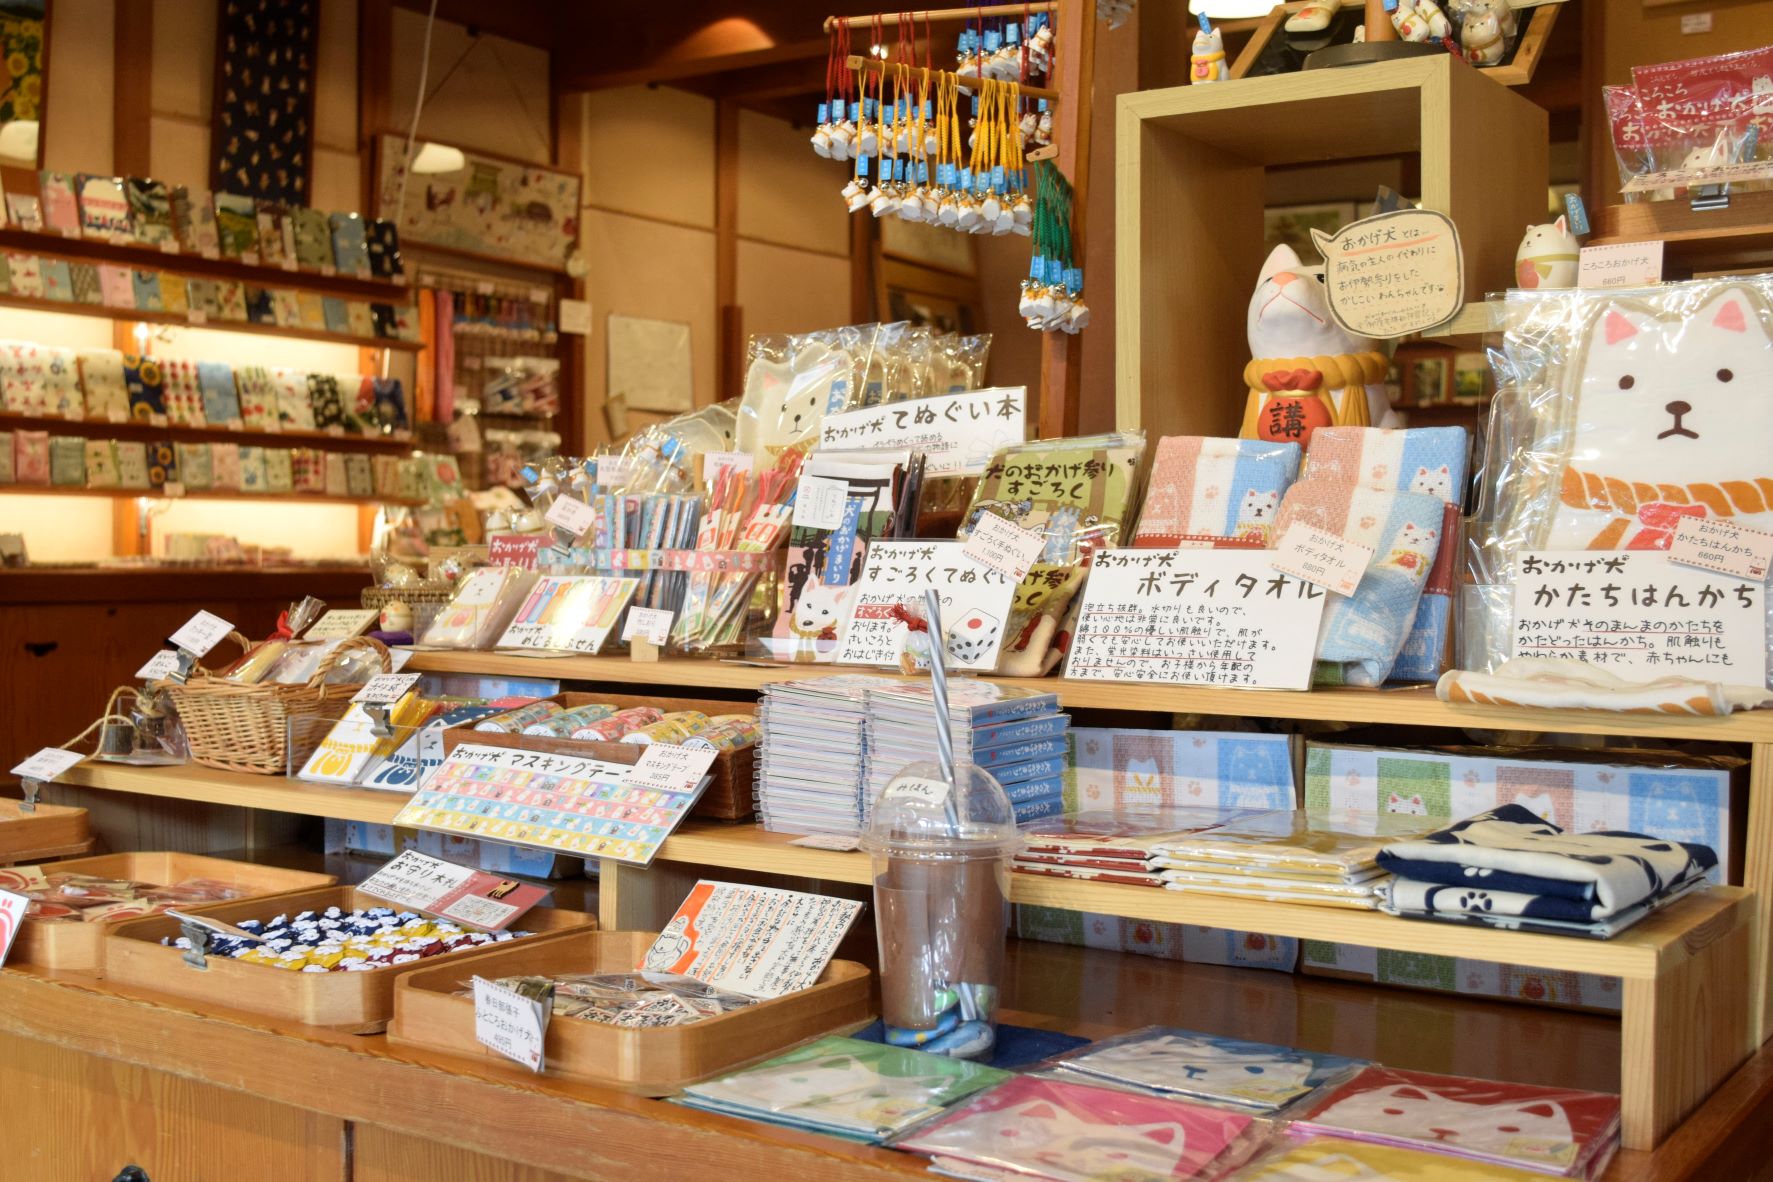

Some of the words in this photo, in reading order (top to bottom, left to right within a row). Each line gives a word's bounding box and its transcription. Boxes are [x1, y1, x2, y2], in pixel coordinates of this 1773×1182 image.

[1582, 255, 1649, 271] ころころおかげ犬
[824, 416, 885, 443] おかげ犬
[892, 393, 1021, 430] てぬぐい本
[1269, 401, 1306, 437] 講
[985, 459, 1115, 480] 犬のおかげ参り
[1007, 480, 1085, 500] すごろく
[992, 523, 1021, 543] おかげ犬
[1698, 524, 1739, 541] おかげ犬
[1308, 532, 1345, 553] おかげ犬
[1676, 533, 1753, 557] かたちはんかち
[869, 545, 935, 561] おかげ犬
[1095, 550, 1177, 569] おかげ犬
[1294, 542, 1346, 568] ボディタオル
[1697, 550, 1725, 564] 660円
[1301, 561, 1326, 577] 880円
[1521, 555, 1625, 575] おかげ犬
[1136, 570, 1324, 600] ボディタオル
[1534, 583, 1756, 609] かたちはんかち
[851, 619, 892, 633] おります。
[1518, 619, 1724, 634] おかげ犬そのまんまのかたちを
[848, 634, 892, 647] さいころと
[843, 649, 895, 662] おはじき付
[452, 747, 504, 762] おかげ犬
[511, 752, 632, 778] マスキングテー
[658, 750, 689, 761] おかげ犬
[645, 759, 689, 773] マスキングテープ
[401, 851, 442, 868] おかげ犬
[390, 861, 458, 889] お守り木札
